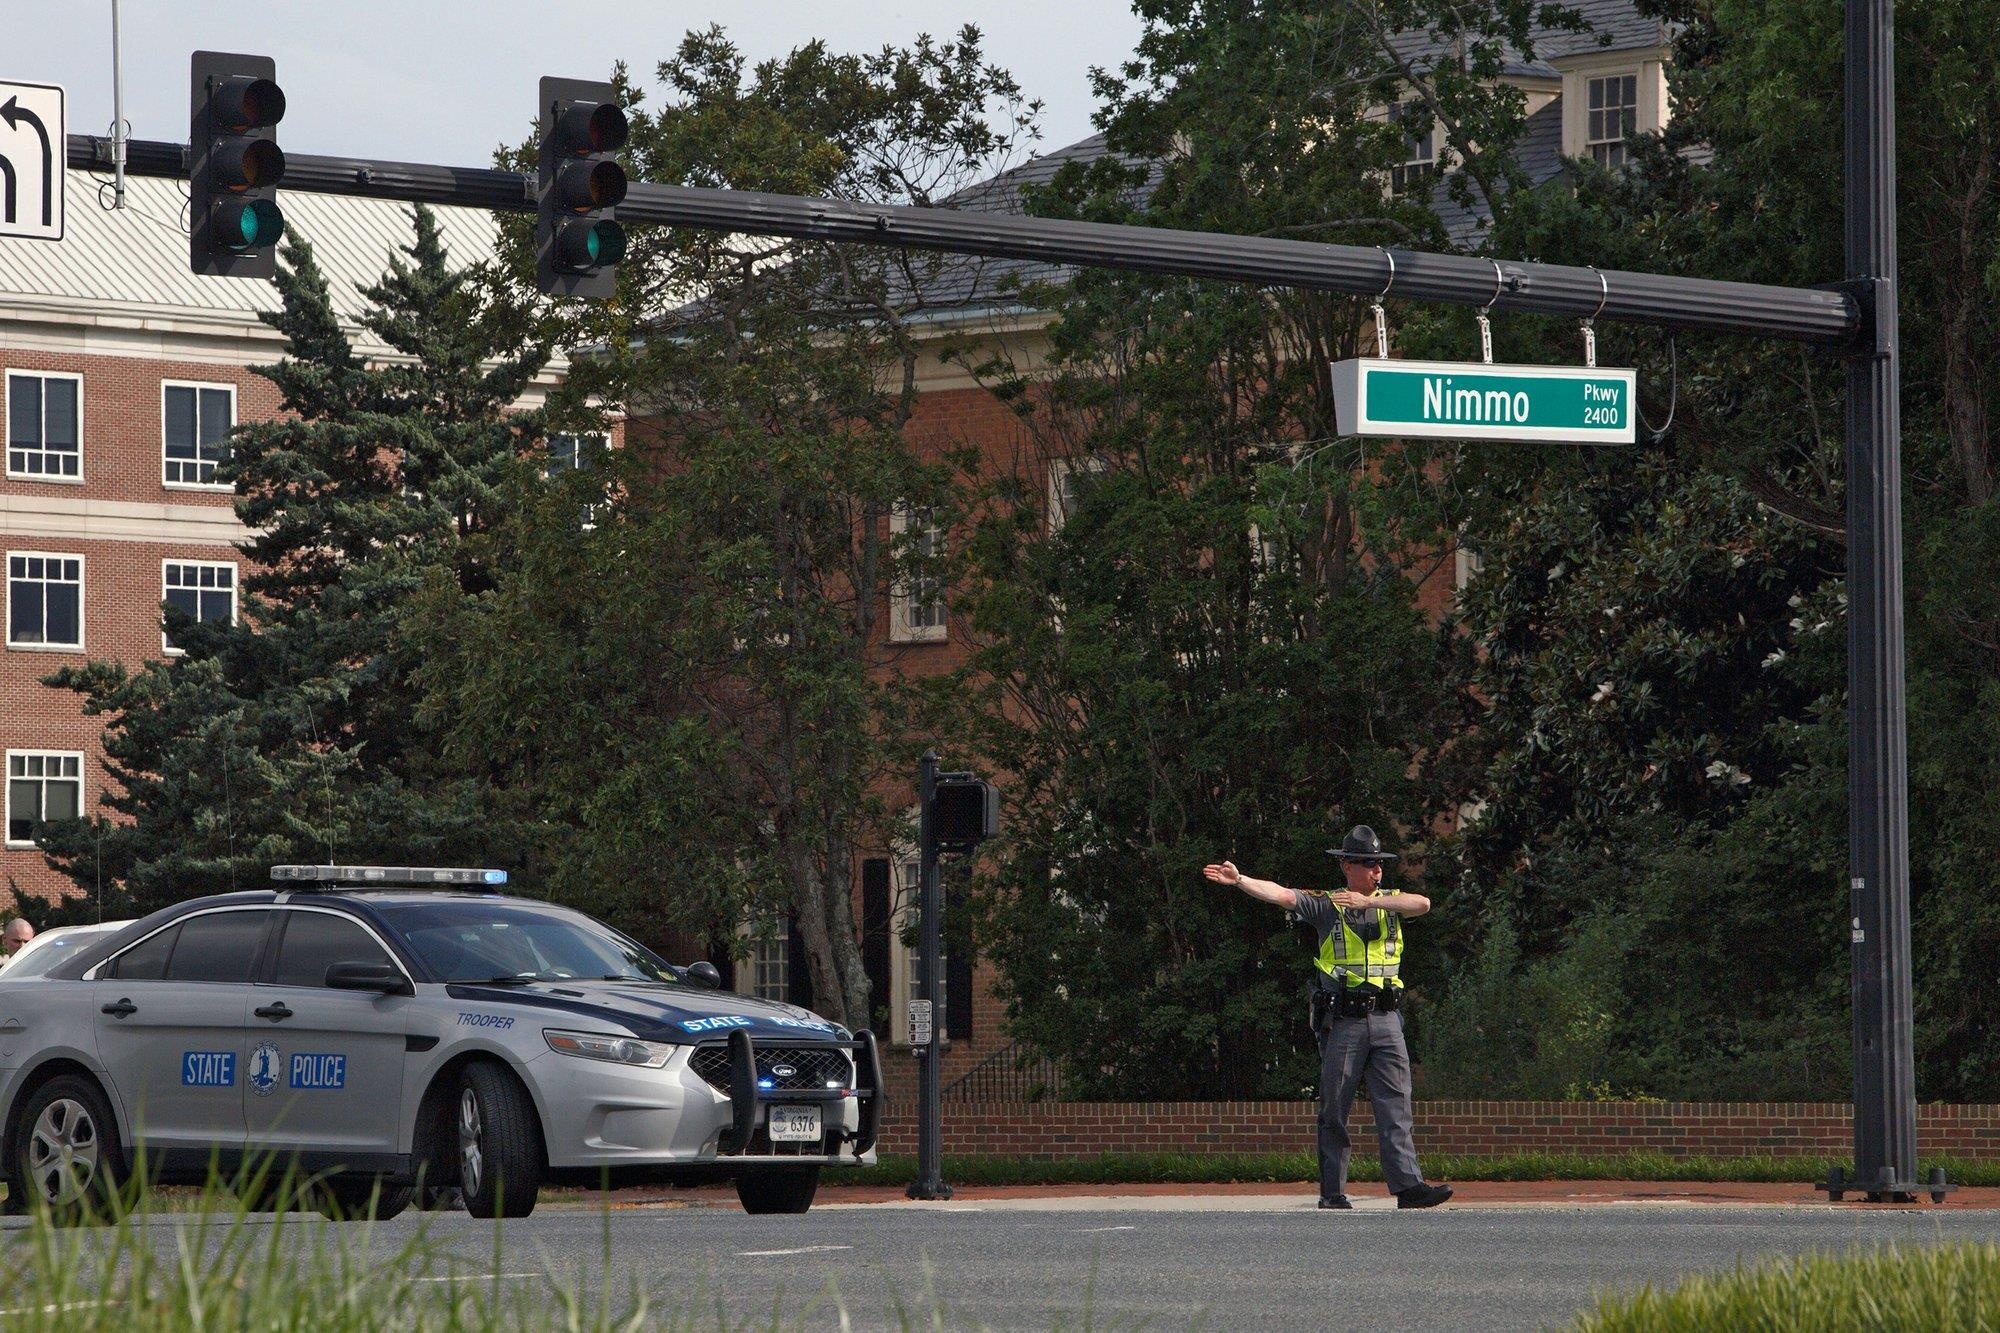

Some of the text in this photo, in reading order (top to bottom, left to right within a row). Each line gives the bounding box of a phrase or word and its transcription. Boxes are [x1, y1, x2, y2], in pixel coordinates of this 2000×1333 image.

[1423, 377, 1530, 423] Nimmo
[1584, 383, 1619, 406] Pkwy
[1584, 407, 1618, 424] 2400
[456, 1012, 515, 1029] TROOPER
[683, 1015, 750, 1032] STATE
[187, 1053, 231, 1084] STATE
[292, 1055, 343, 1086] POLICE
[790, 1115, 815, 1132] 6376
